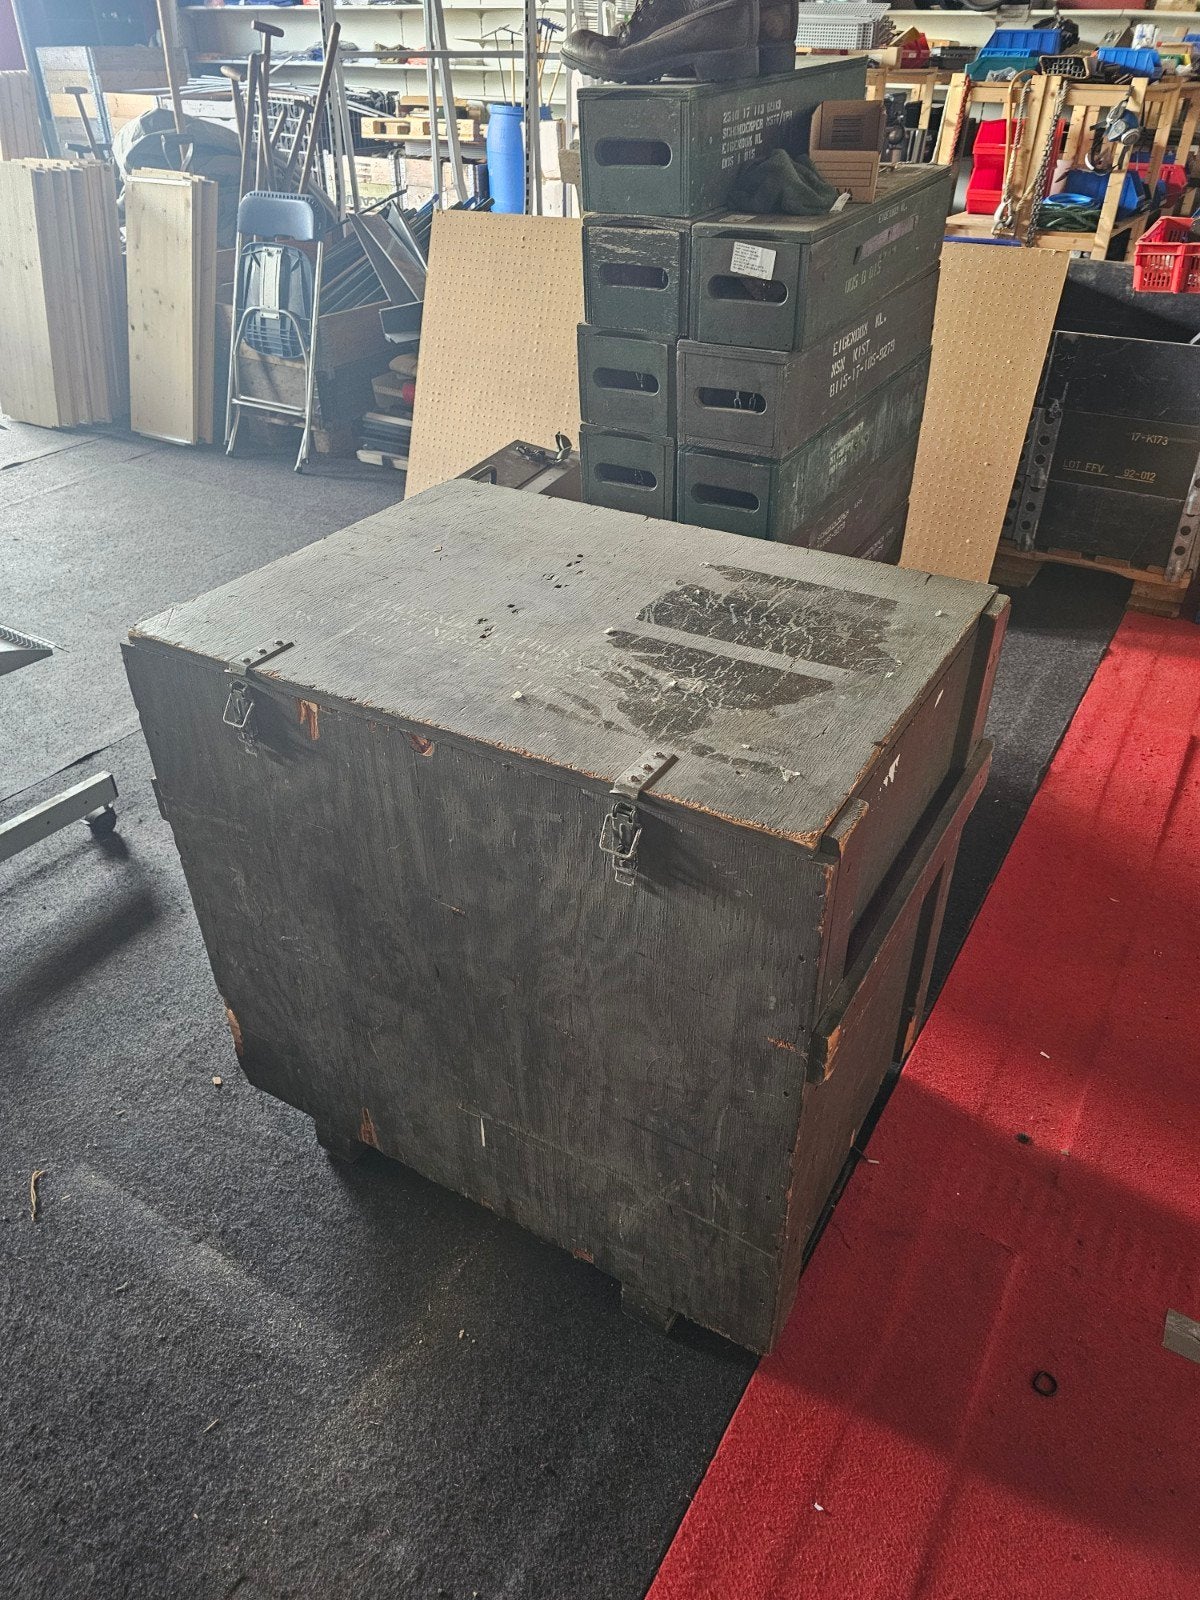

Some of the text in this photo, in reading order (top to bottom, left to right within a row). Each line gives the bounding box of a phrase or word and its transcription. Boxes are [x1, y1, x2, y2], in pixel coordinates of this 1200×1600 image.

[852, 339, 871, 363] KIST
[1131, 432, 1169, 446] 17-K173
[1063, 459, 1157, 481] LOT FFV 92-012
